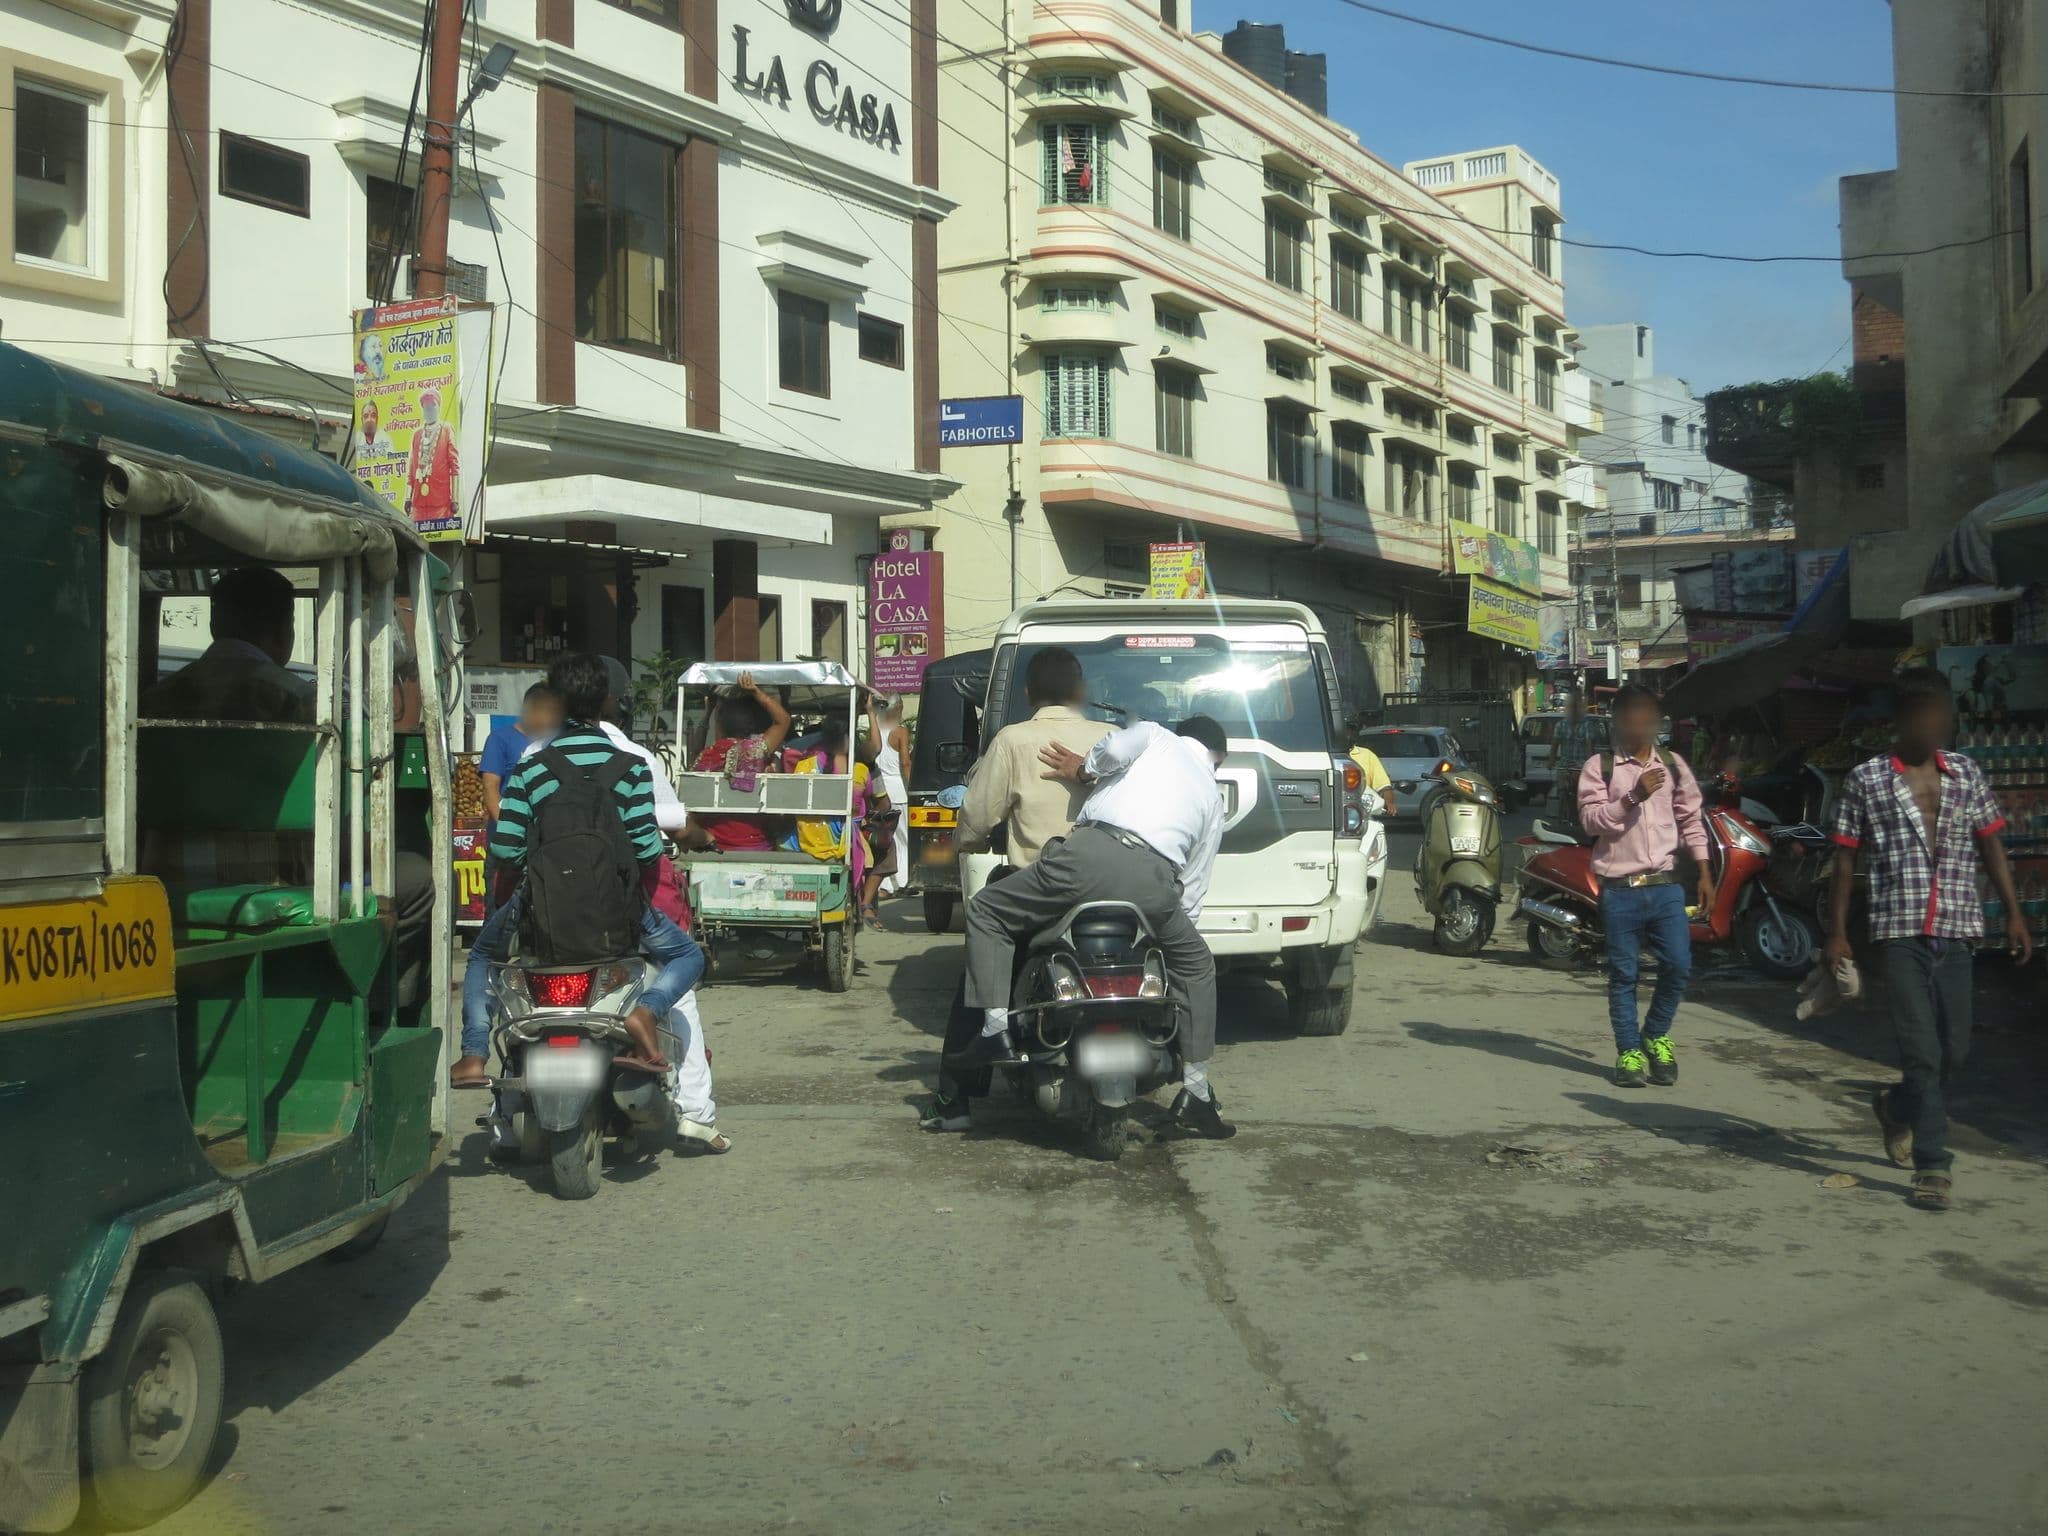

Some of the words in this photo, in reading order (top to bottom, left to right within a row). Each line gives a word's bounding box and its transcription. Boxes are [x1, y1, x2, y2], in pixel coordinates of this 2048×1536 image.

[732, 24, 792, 106] LA
[804, 59, 902, 149] CASA
[436, 320, 453, 346] मेले
[393, 361, 402, 371] के
[442, 354, 452, 364] पर
[941, 425, 1016, 442] FABHOTELS
[874, 557, 921, 578] Hotel
[875, 580, 906, 601] LA
[874, 602, 930, 624] CASA
[784, 890, 817, 902] EXIDE
